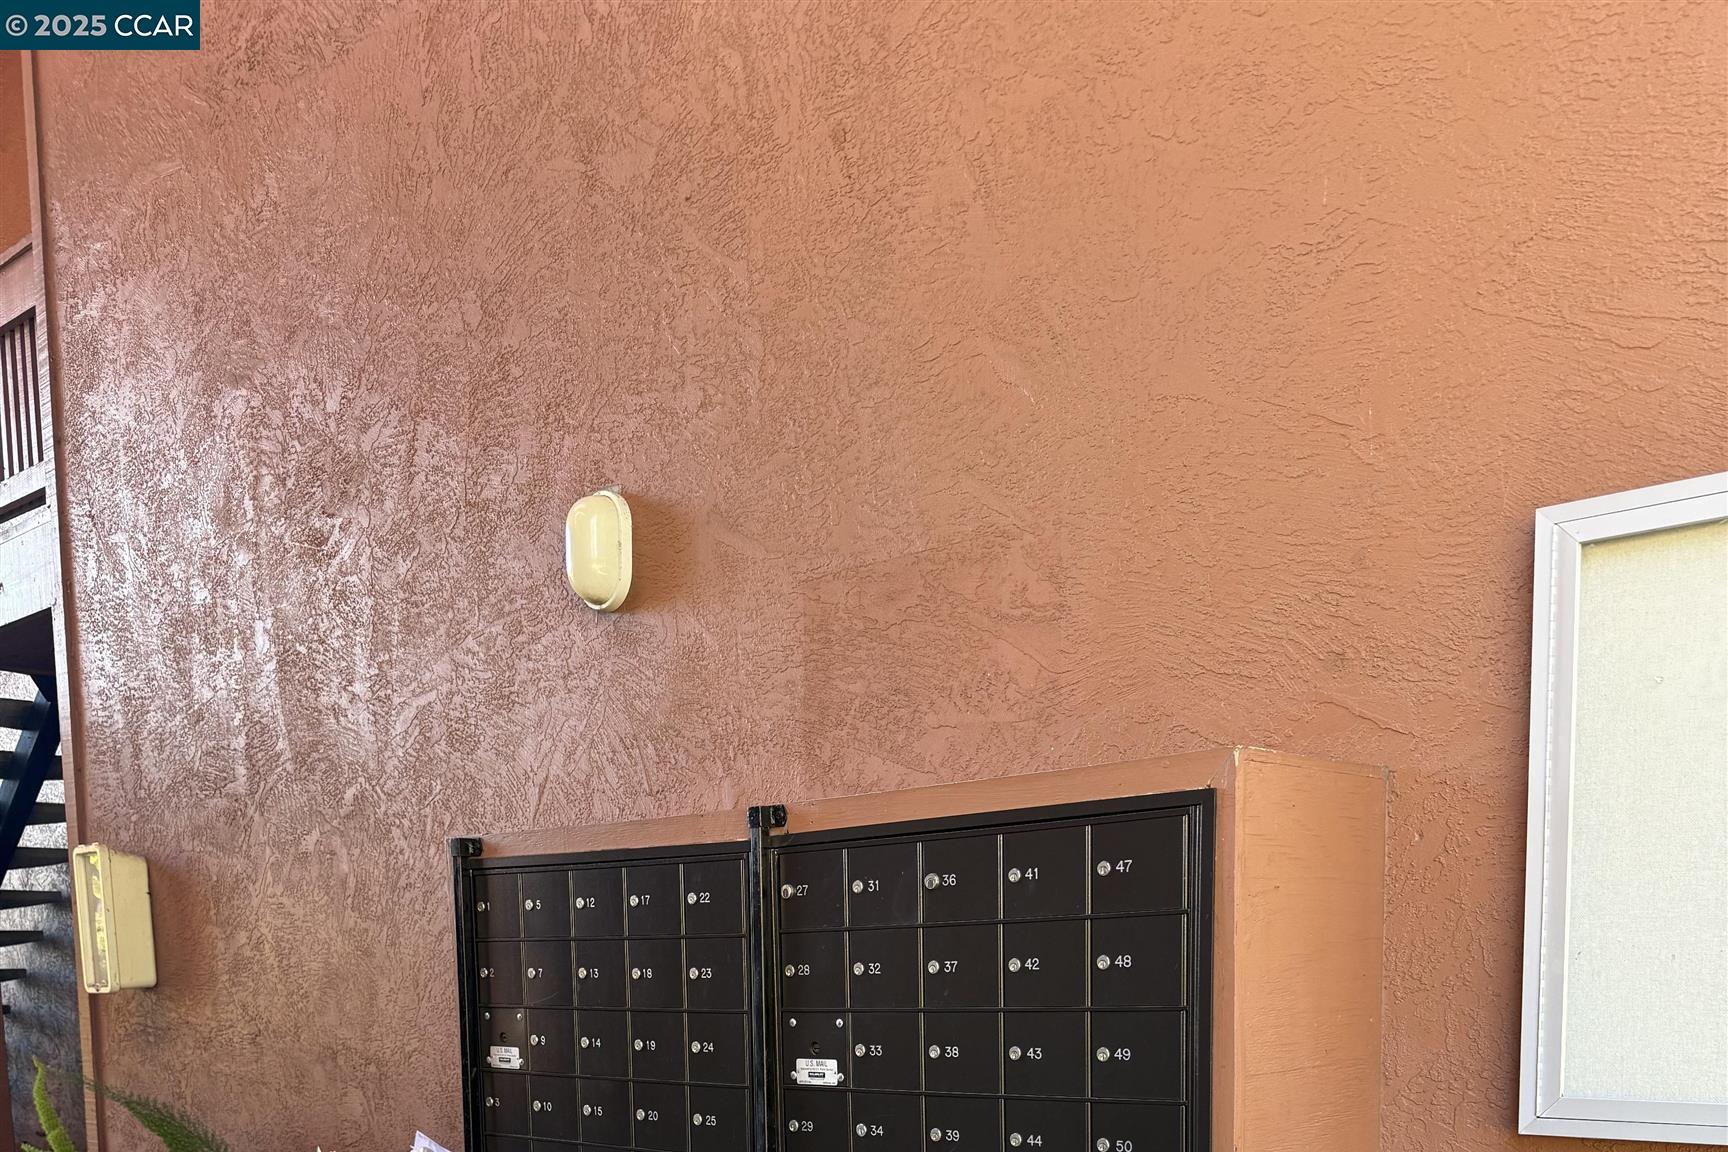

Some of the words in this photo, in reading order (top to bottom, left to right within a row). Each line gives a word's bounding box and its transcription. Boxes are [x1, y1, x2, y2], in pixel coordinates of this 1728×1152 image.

[1115, 859, 1133, 873] 47
[1024, 867, 1038, 880] 41
[867, 879, 879, 892] 31
[942, 873, 957, 887] 36
[796, 884, 809, 897] 27
[586, 897, 596, 908] 12
[640, 894, 651, 906] 17
[699, 892, 711, 904] 22
[535, 899, 542, 910] 5
[943, 960, 958, 973] 37
[1024, 957, 1040, 970] 42
[1114, 954, 1132, 968] 48
[489, 967, 495, 978] 2
[537, 968, 543, 978] 7
[589, 968, 599, 979] 13
[642, 968, 653, 979] 18
[700, 967, 712, 979] 23
[797, 964, 810, 976] 28
[868, 962, 881, 975] 32
[540, 1035, 546, 1046] 9
[591, 1037, 601, 1048] 14
[646, 1040, 656, 1051] 19
[702, 1041, 714, 1053] 24
[869, 1044, 883, 1057] 33
[944, 1046, 959, 1058] 38
[1026, 1047, 1043, 1060] 43
[1113, 1048, 1131, 1061] 49
[815, 1060, 828, 1068] MAIL
[494, 1097, 501, 1107] 3
[543, 1101, 553, 1112] 10
[593, 1105, 603, 1117] 15
[647, 1110, 659, 1121] 20
[705, 1114, 717, 1126] 25
[801, 1120, 814, 1132] 29
[870, 1124, 884, 1137] 34
[945, 1129, 960, 1142] 39
[1026, 1134, 1043, 1147] 44
[1115, 1140, 1133, 1152] 50
